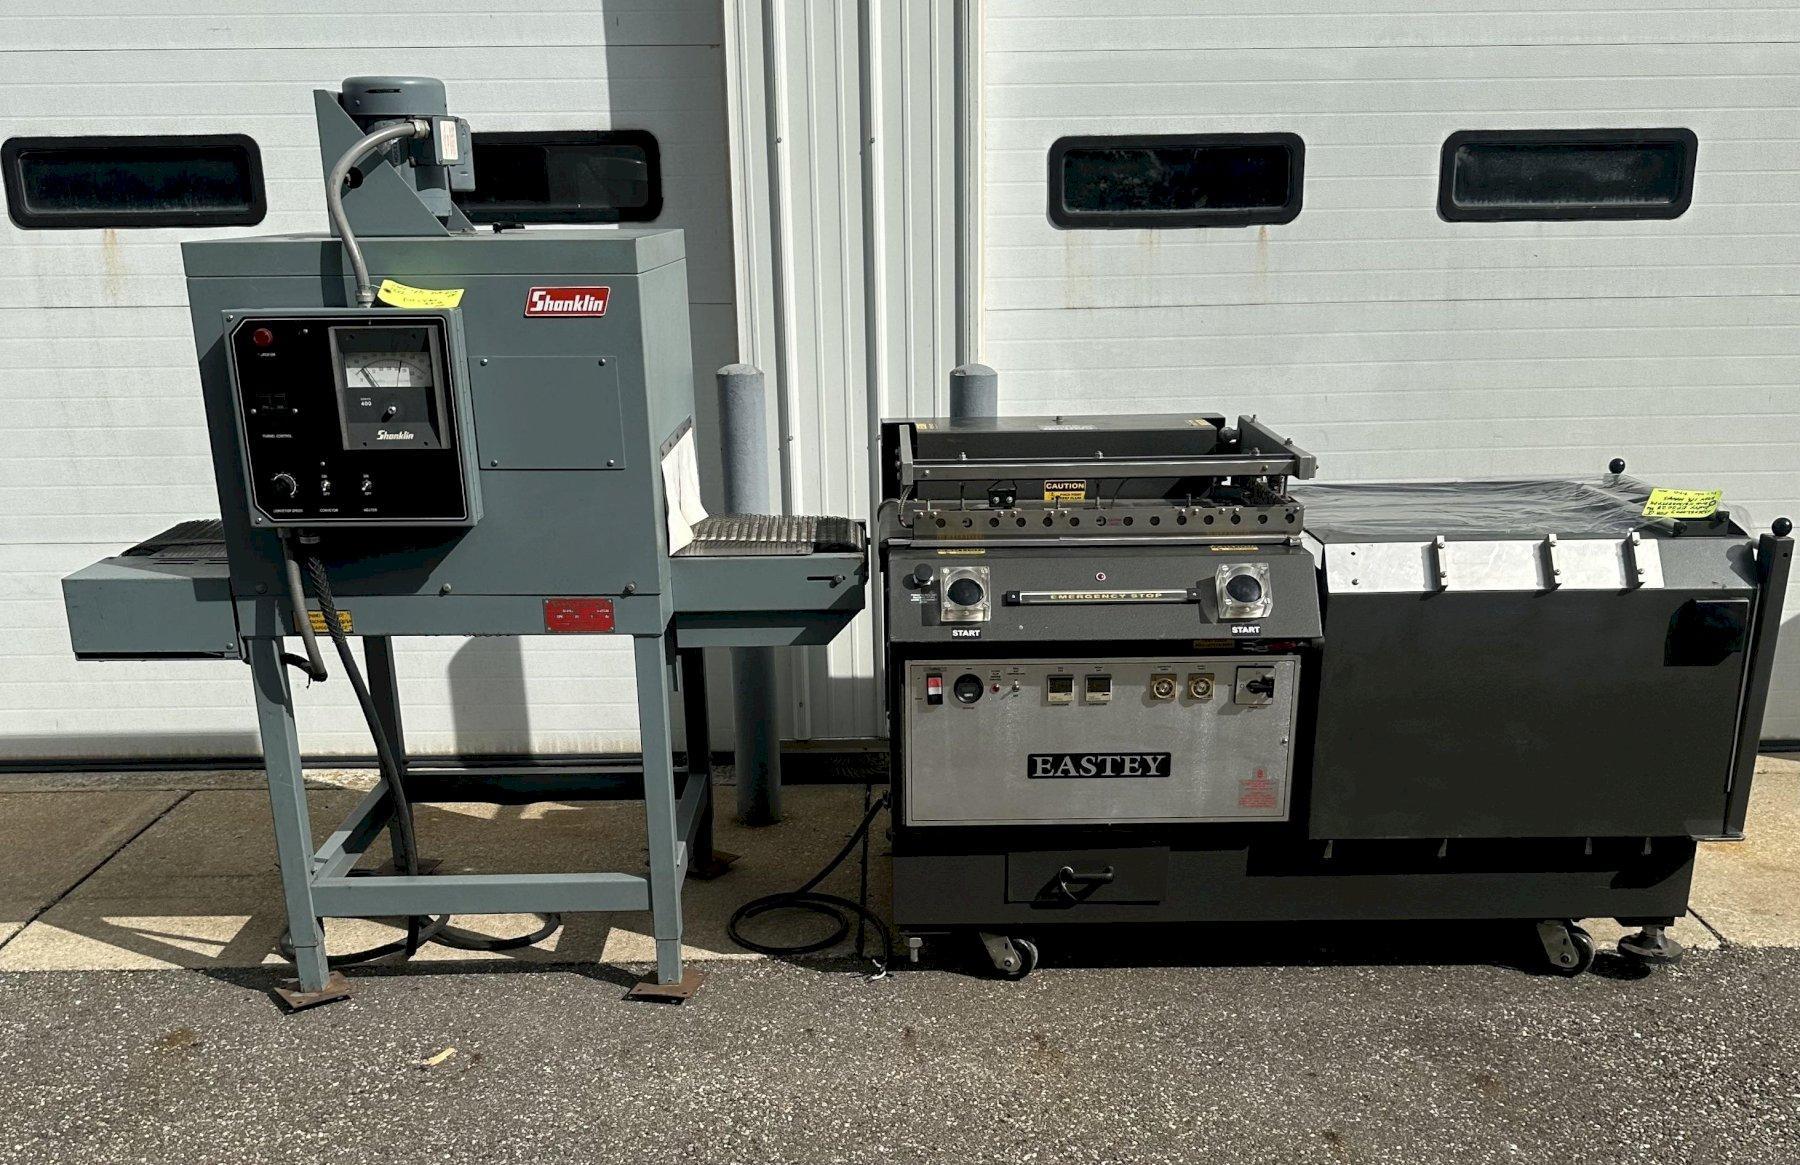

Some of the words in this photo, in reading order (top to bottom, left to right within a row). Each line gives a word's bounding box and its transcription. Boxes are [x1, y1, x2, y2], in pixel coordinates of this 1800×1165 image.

[530, 291, 604, 311] Shanklin
[377, 429, 414, 440] Shanklin
[1046, 482, 1085, 490] CAUTION
[952, 629, 981, 637] START
[1232, 626, 1261, 634] START
[1032, 755, 1167, 777] EASTEY
